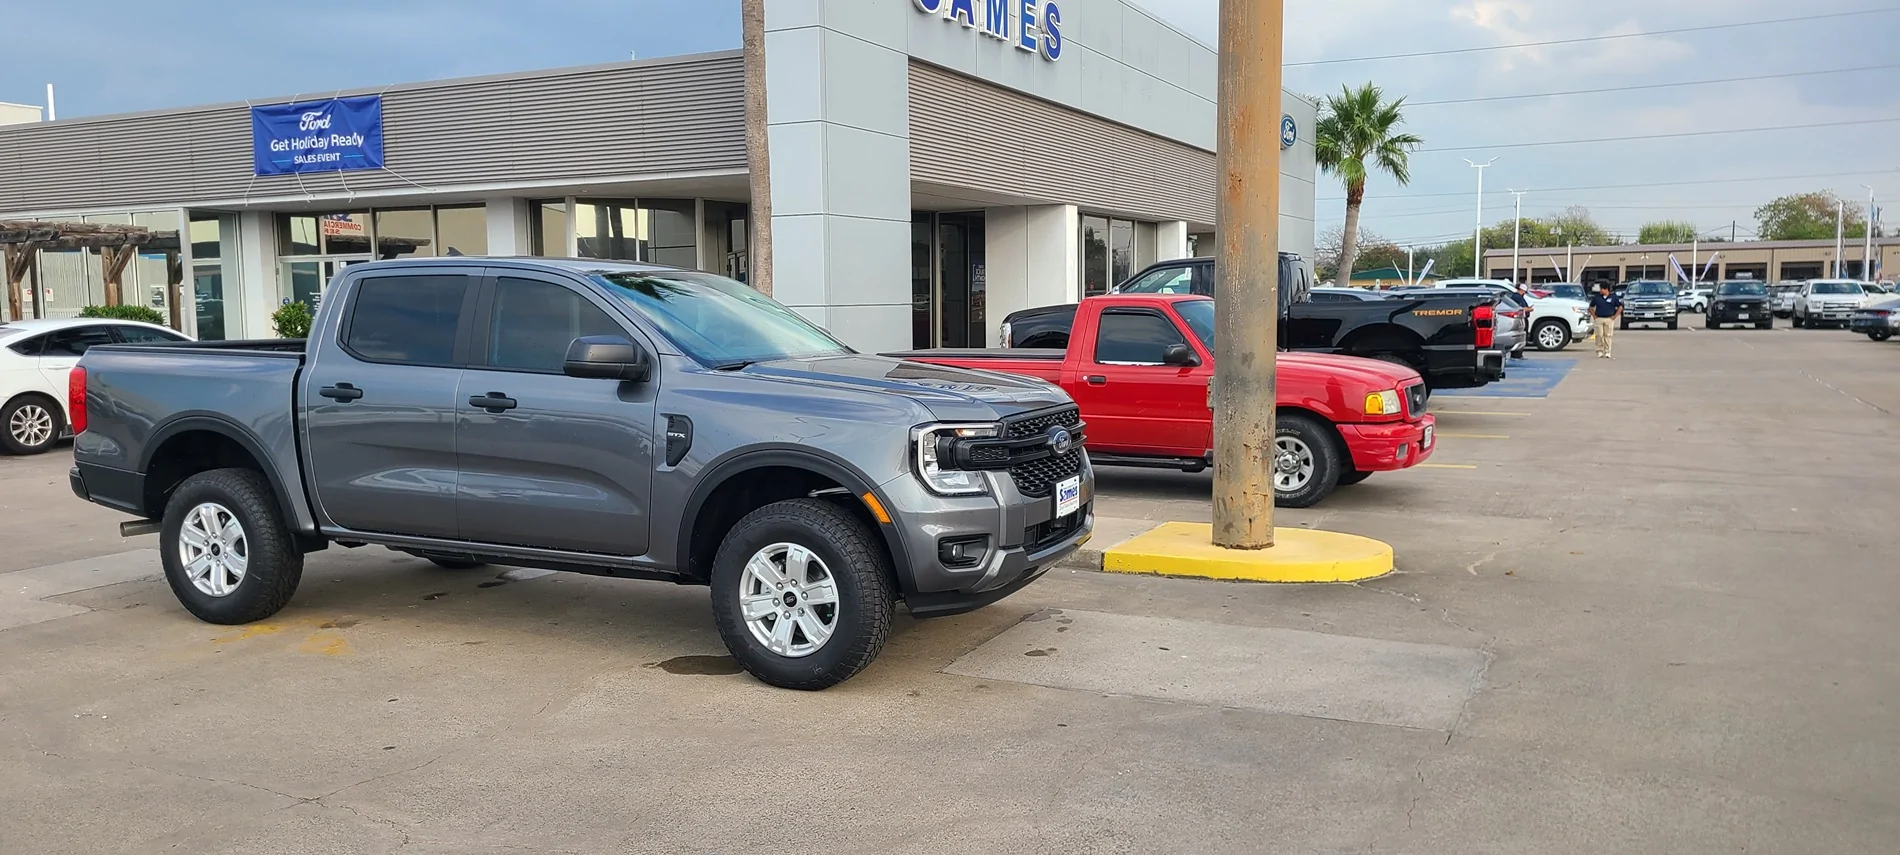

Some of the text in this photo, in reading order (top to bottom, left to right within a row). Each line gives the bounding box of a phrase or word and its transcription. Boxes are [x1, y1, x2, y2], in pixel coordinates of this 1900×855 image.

[913, 0, 1063, 62] MES
[300, 111, 331, 131] Ford
[270, 132, 364, 151] Get Holiday Ready
[294, 152, 341, 164] SALES EVENT
[1413, 309, 1463, 317] TREMOR
[1060, 486, 1078, 502] Sames
